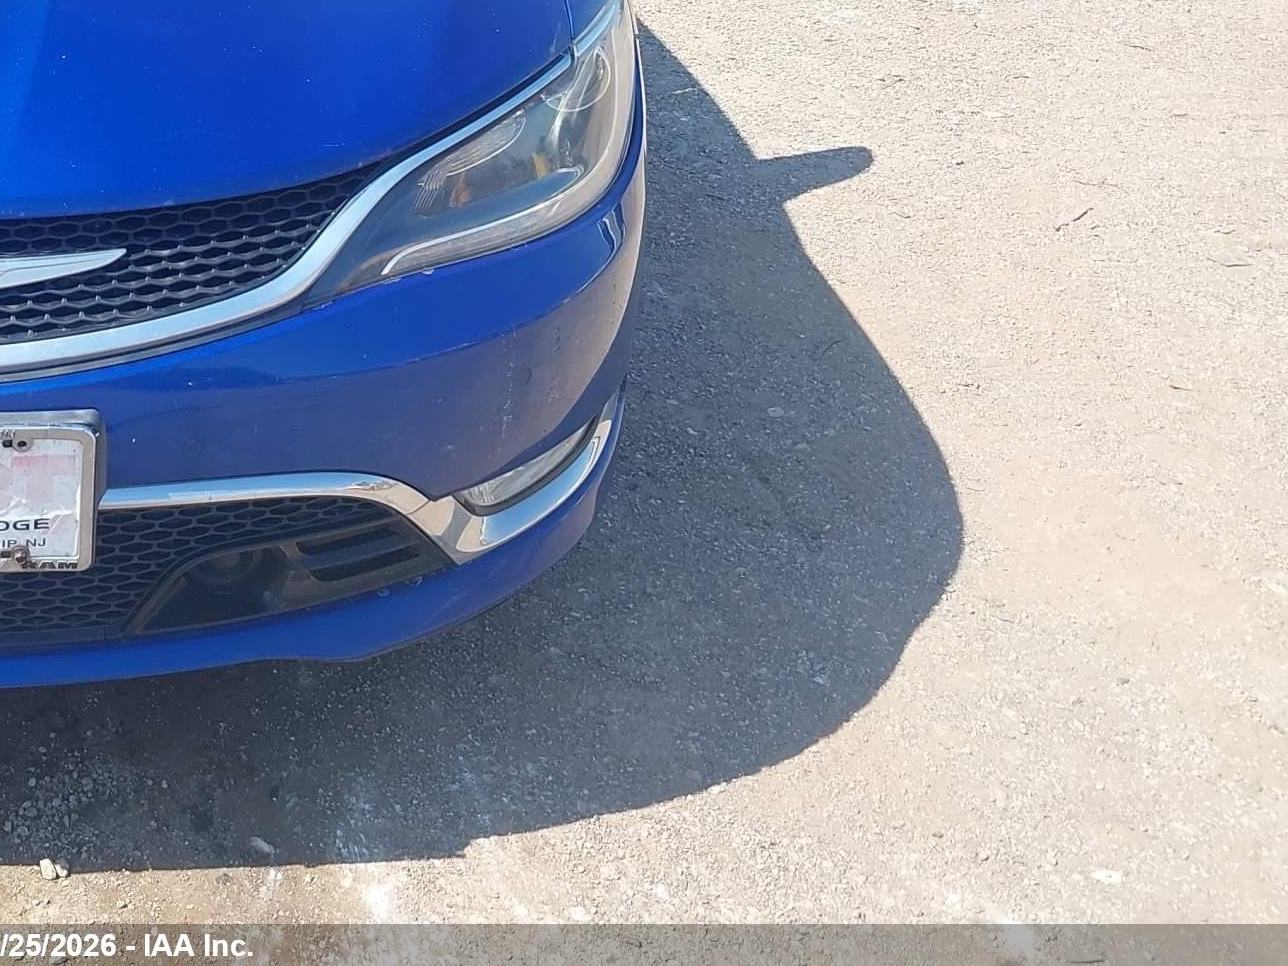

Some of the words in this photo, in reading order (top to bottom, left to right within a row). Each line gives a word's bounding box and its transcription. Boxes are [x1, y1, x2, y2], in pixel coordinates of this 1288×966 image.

[0, 429, 16, 439] NJ
[26, 537, 47, 548] NJ
[22, 560, 78, 571] RAM
